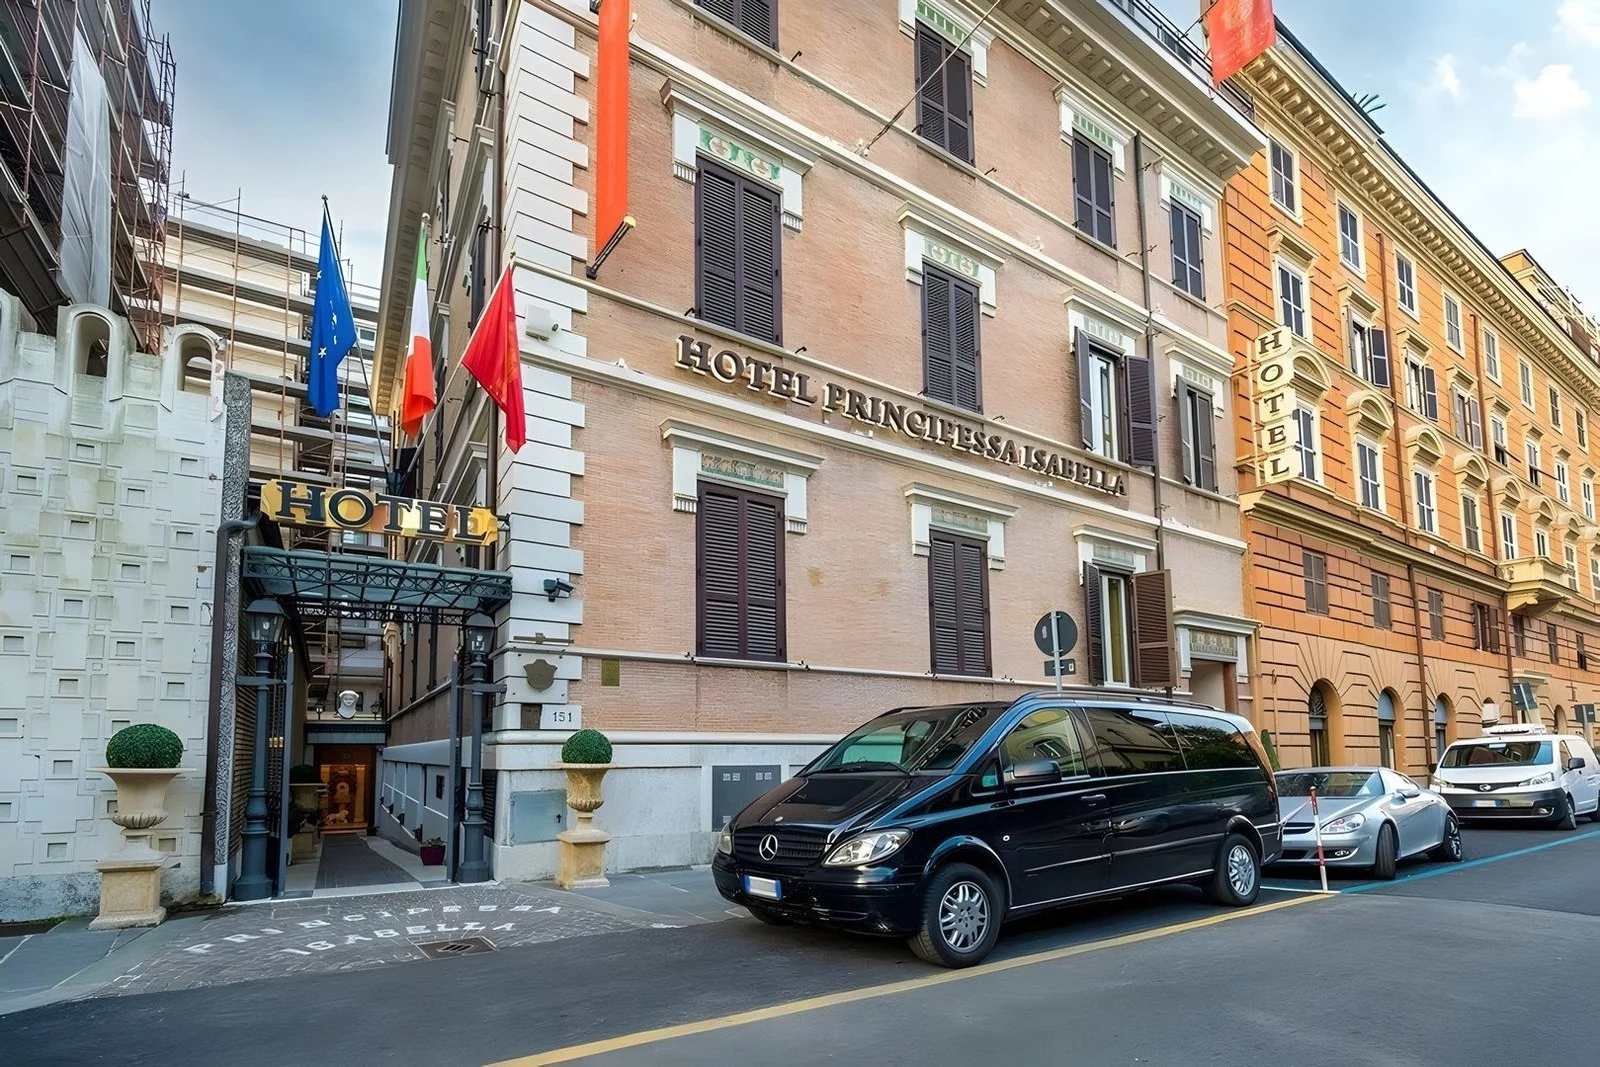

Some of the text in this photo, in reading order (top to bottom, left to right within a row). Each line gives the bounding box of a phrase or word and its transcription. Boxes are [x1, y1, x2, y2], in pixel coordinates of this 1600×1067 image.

[675, 334, 1127, 497] HOTEL PRINCIPESSA ISABELLA
[1258, 330, 1289, 477] HOTEL
[275, 480, 488, 541] HOTEL
[553, 711, 572, 722] 151
